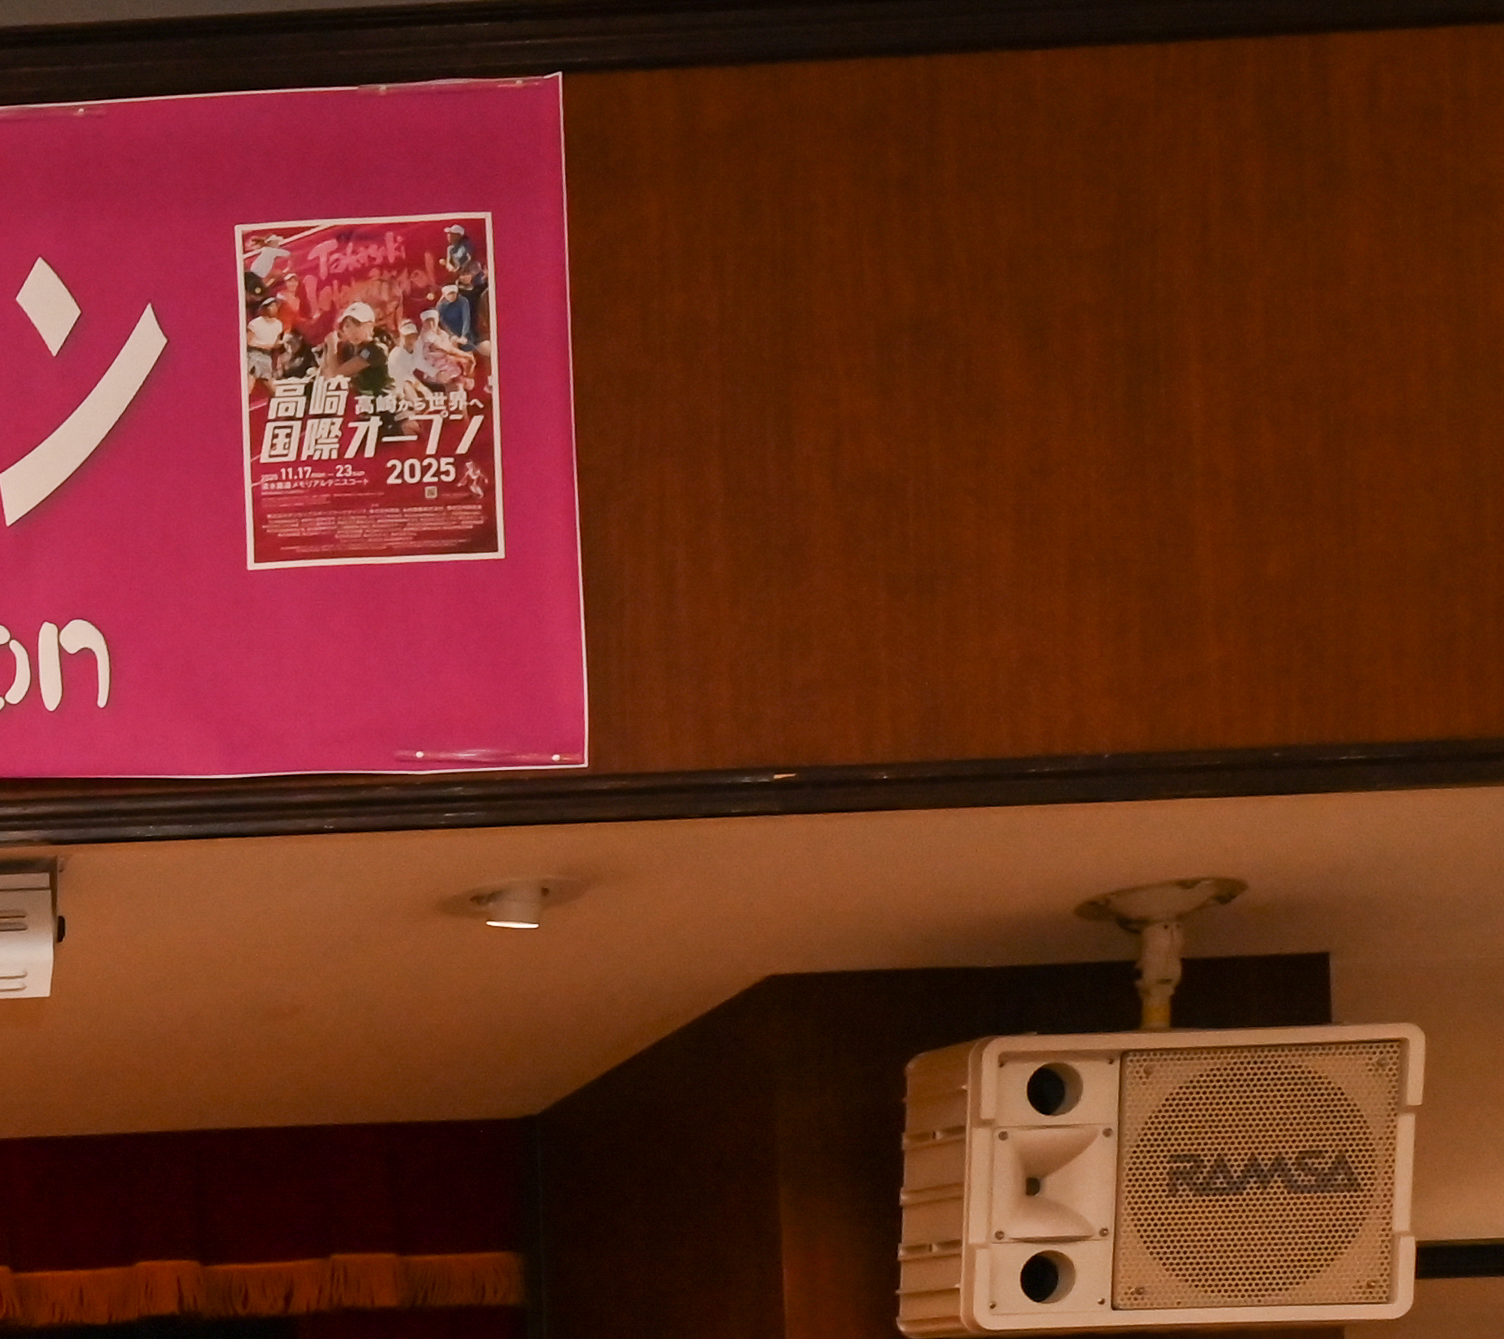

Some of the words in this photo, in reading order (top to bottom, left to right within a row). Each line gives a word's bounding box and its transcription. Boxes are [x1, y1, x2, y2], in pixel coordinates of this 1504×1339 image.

[268, 375, 351, 419] 高崎
[259, 411, 485, 464] 国際オープン
[386, 457, 457, 484] 2025
[1166, 1149, 1364, 1197] RAMSA
